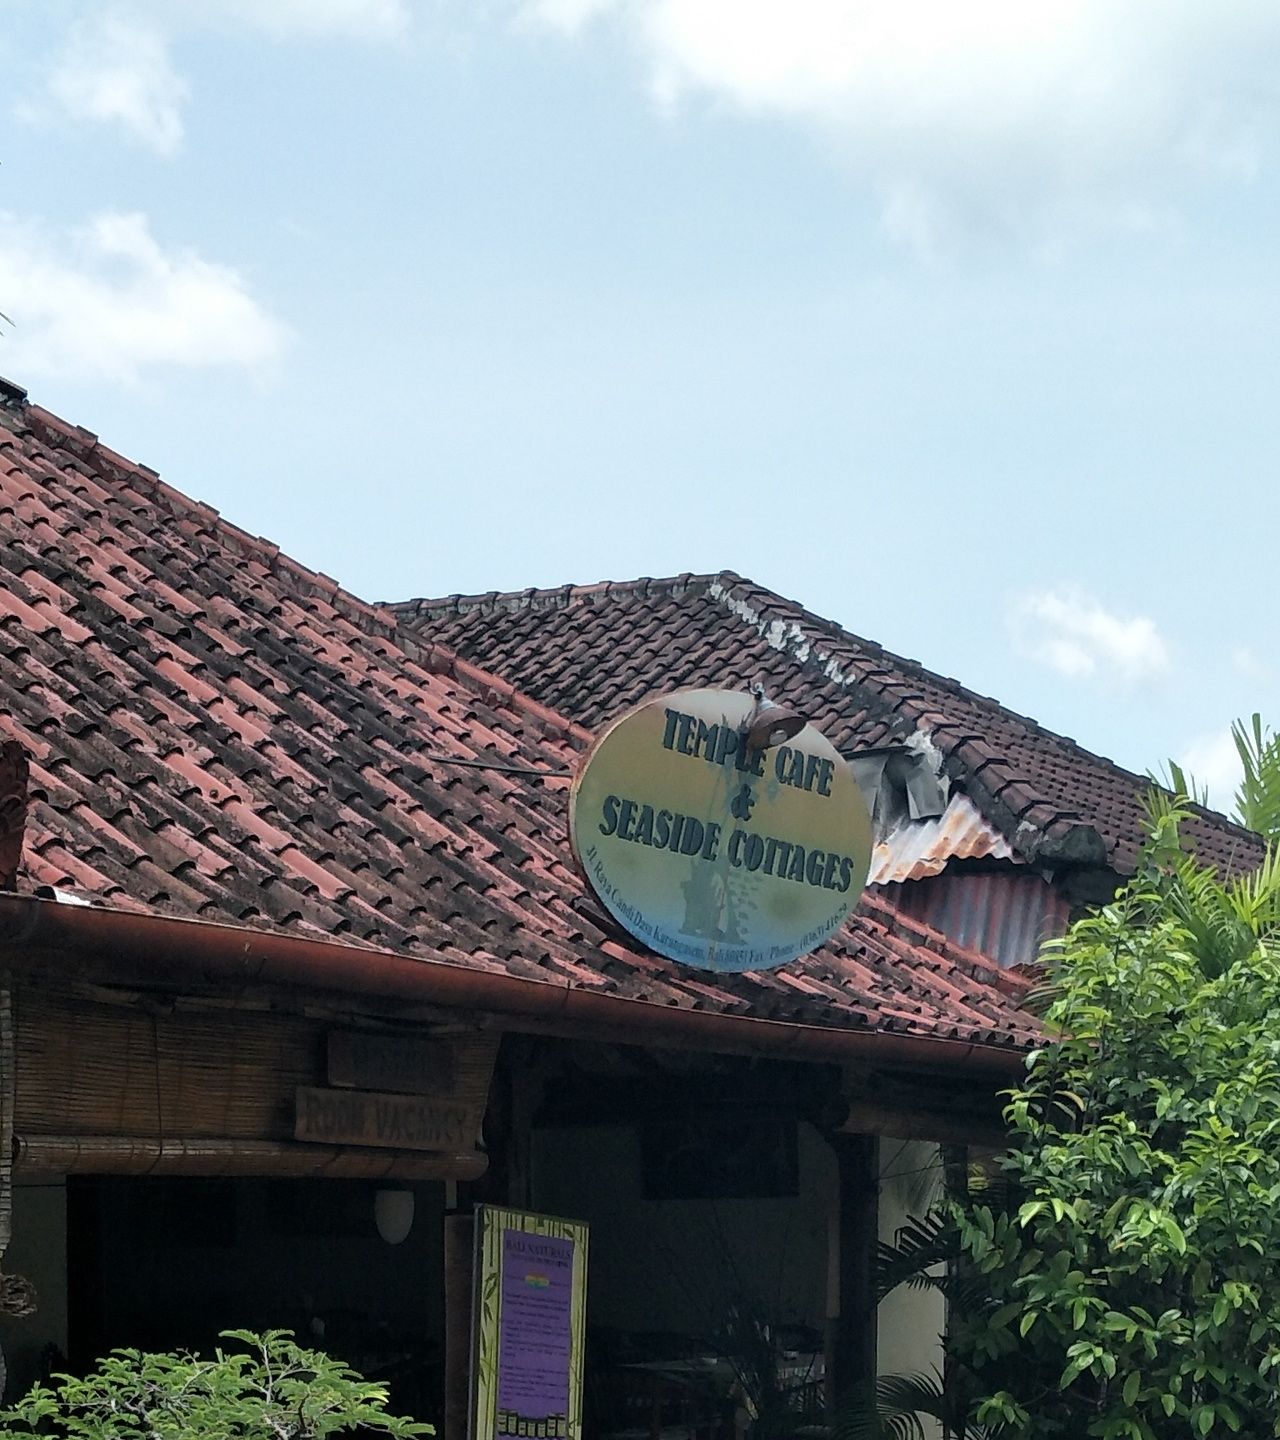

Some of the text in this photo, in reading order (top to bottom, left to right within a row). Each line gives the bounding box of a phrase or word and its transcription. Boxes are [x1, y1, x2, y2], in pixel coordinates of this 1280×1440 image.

[663, 707, 835, 797] TEMPLE CAFE
[598, 795, 854, 893] SEASIDE COTTAGES
[730, 784, 755, 821] &
